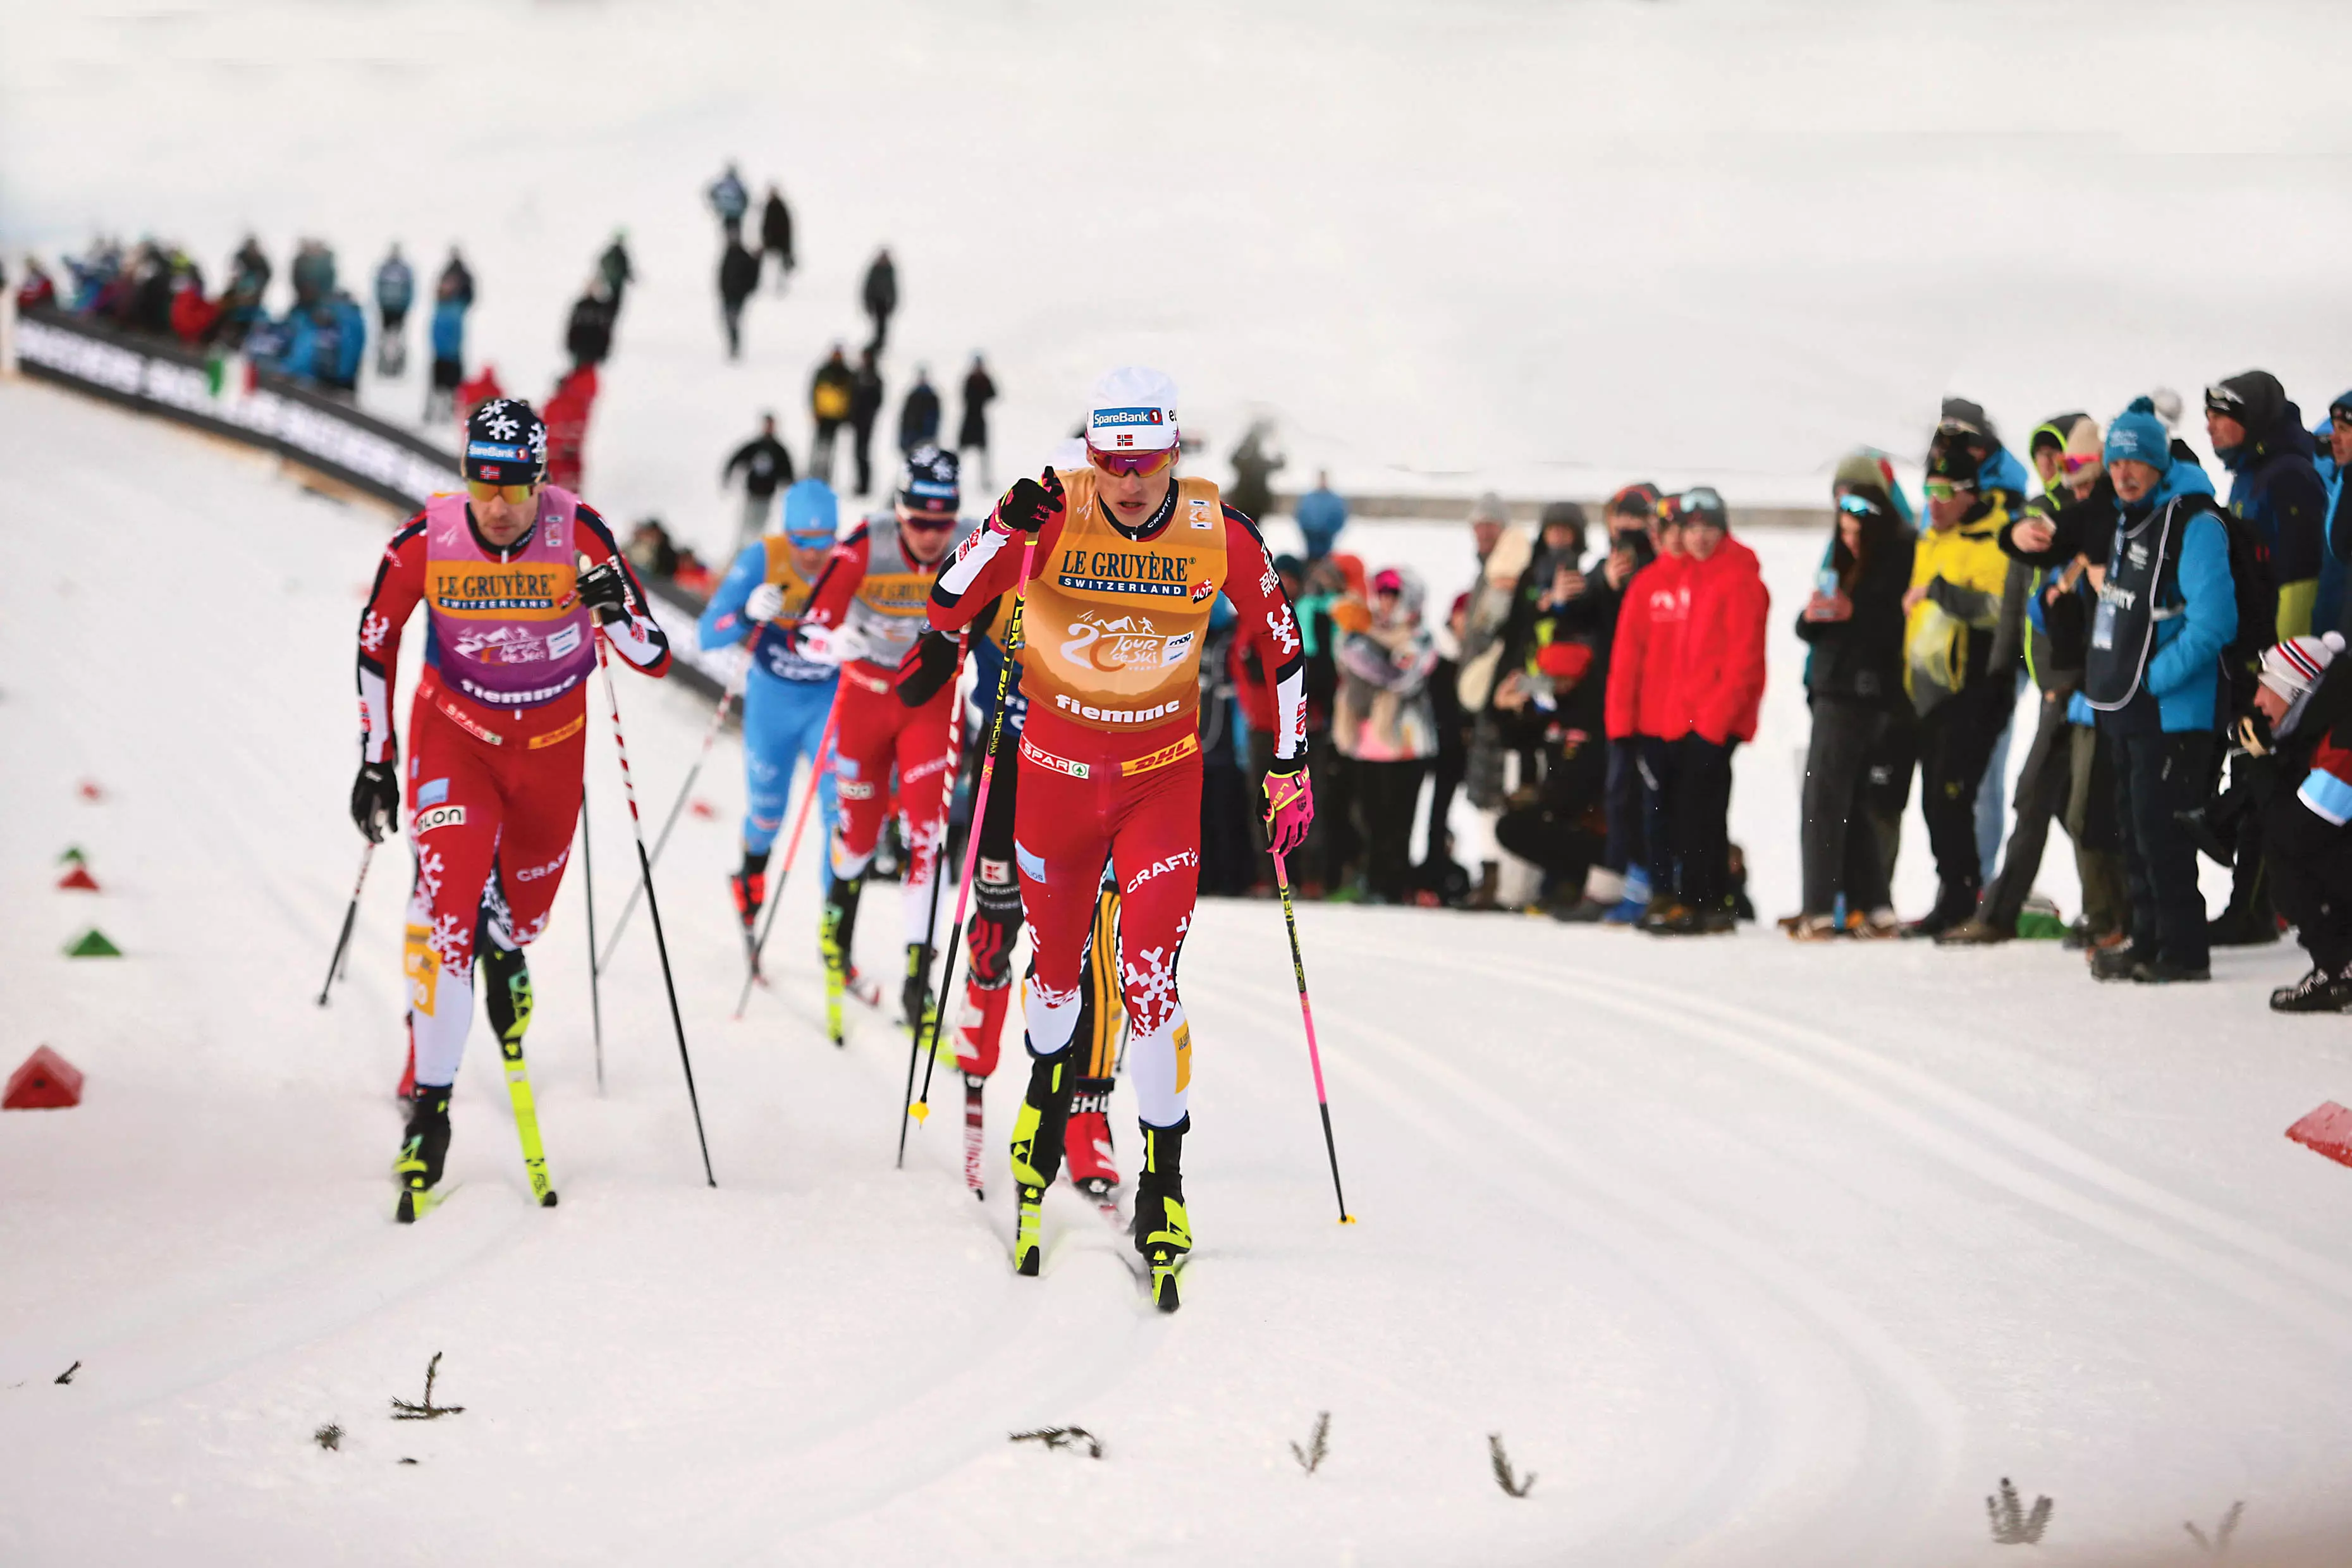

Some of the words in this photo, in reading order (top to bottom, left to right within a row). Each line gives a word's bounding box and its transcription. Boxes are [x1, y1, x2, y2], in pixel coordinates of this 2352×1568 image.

[1094, 412, 1148, 426] SpareBank
[1148, 502, 1169, 529] CRAFT
[1060, 551, 1086, 575] LE
[438, 576, 458, 597] LE
[463, 571, 552, 597] GRUYÈRE
[1064, 578, 1182, 595] SWITZERLAND
[1192, 586, 1213, 601] AOP
[441, 599, 549, 609] SWITZERLAND
[1024, 743, 1068, 771] SPAR
[1135, 742, 1190, 771] DHL
[1127, 852, 1191, 893] CRAFT
